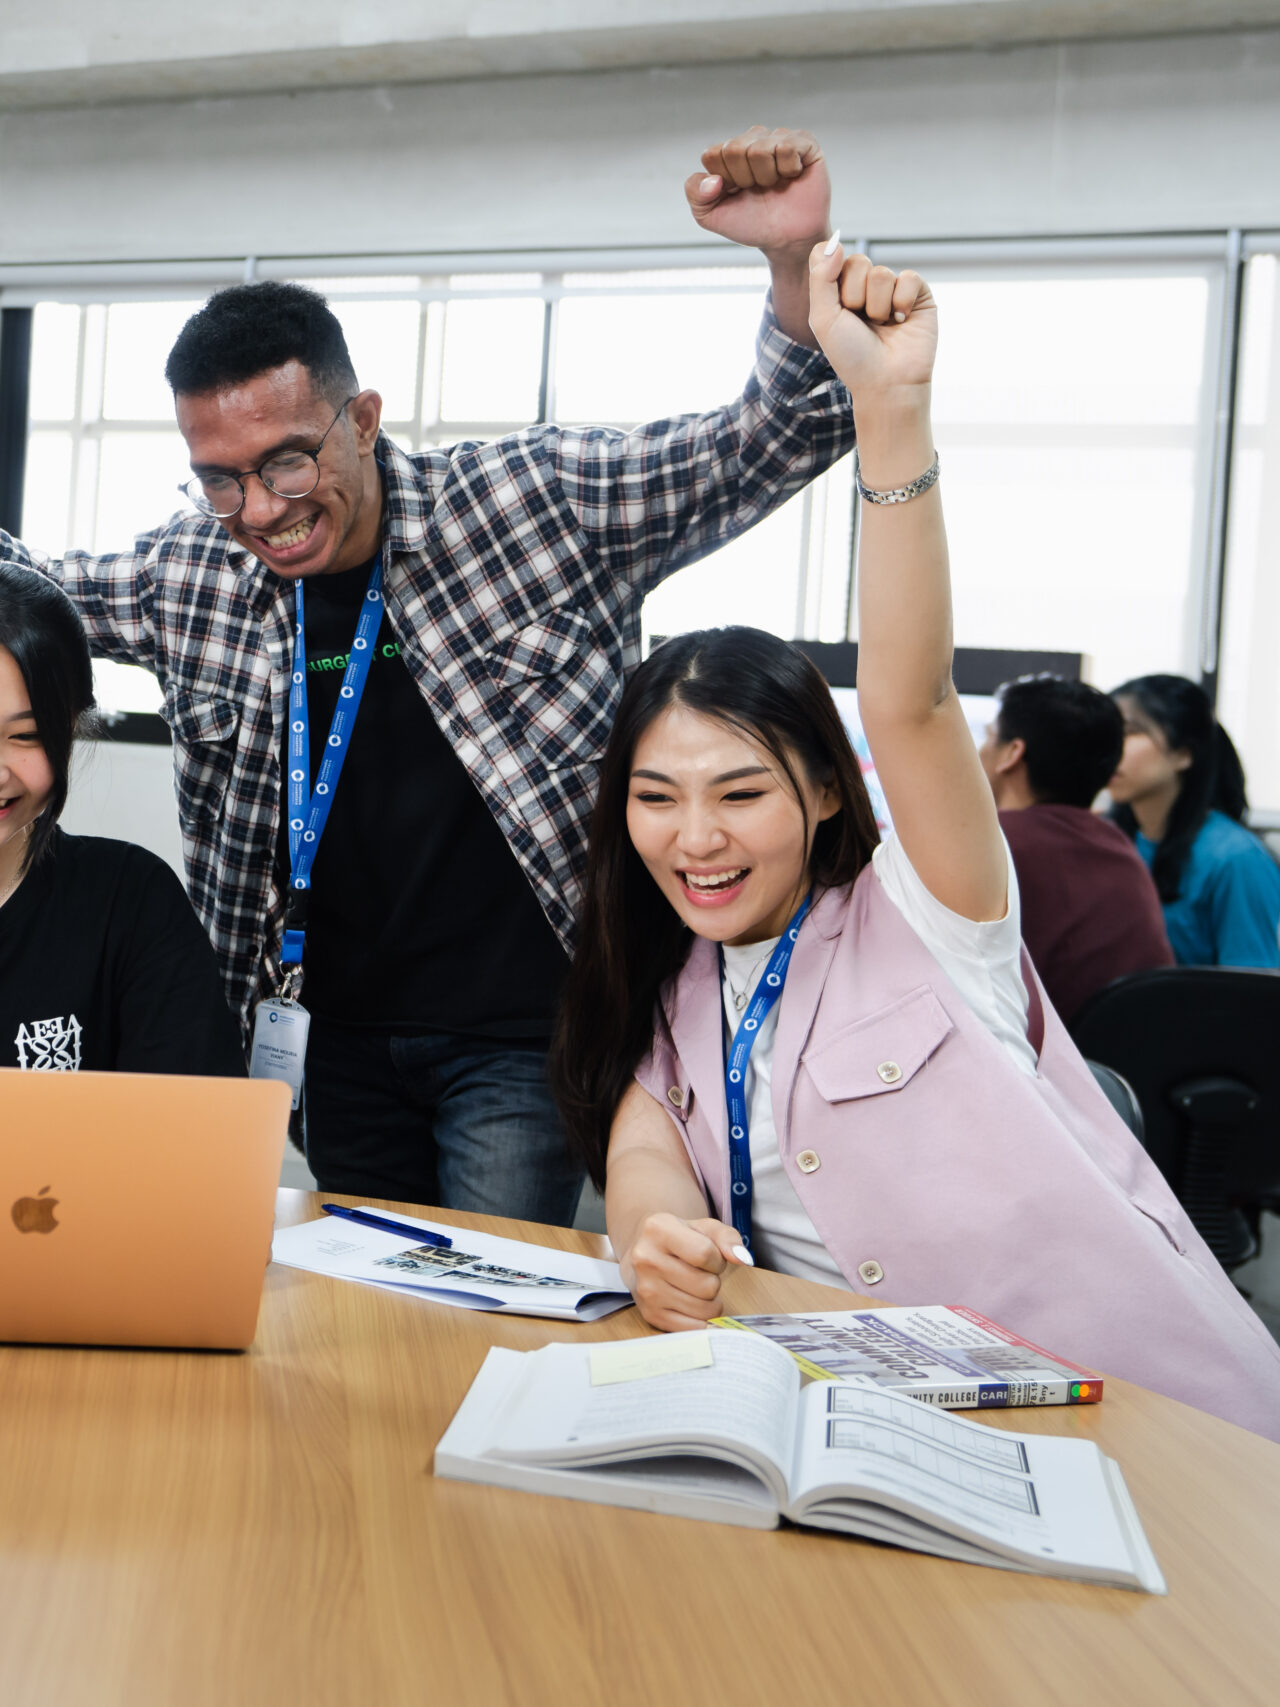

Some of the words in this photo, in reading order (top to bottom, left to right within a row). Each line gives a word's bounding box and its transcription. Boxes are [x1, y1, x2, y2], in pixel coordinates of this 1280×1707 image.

[864, 1318, 912, 1342] TRACK
[795, 1318, 929, 1378] COMMUNITY
[842, 1326, 938, 1366] COLLEGE
[938, 1392, 976, 1403] COLLEGE
[1040, 1385, 1048, 1402] Sny
